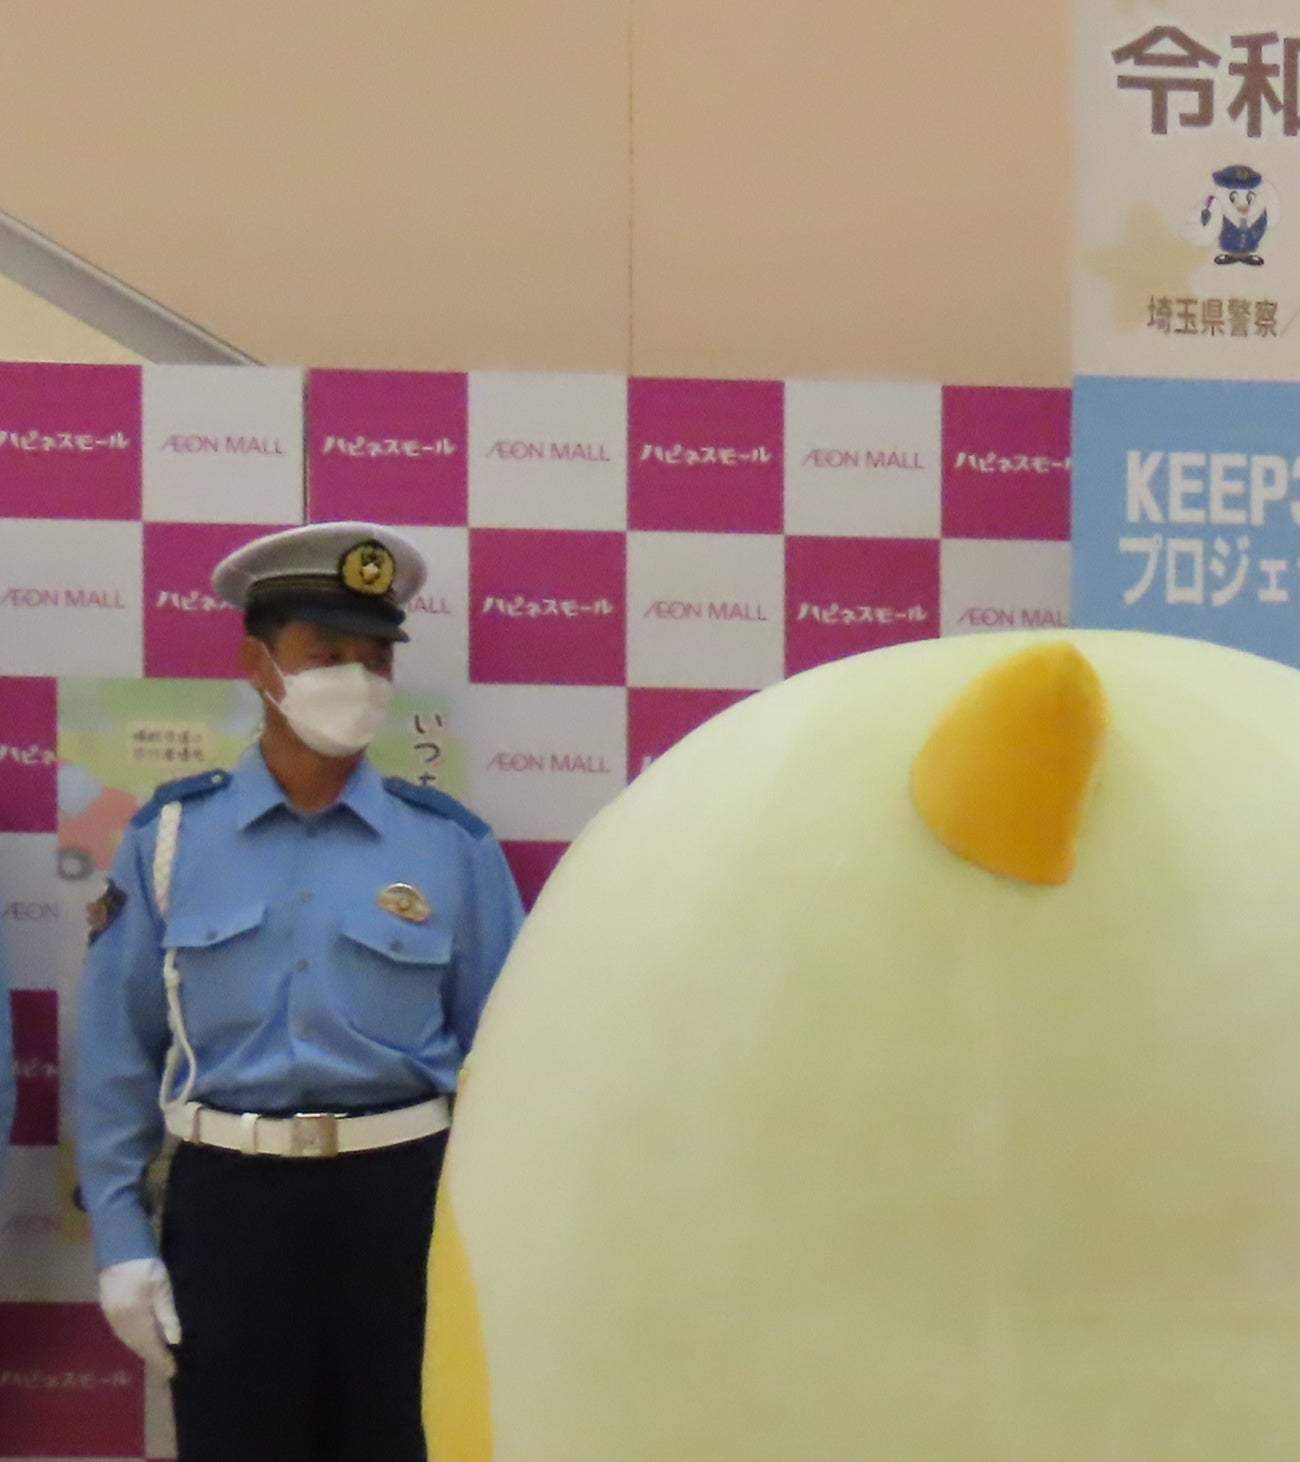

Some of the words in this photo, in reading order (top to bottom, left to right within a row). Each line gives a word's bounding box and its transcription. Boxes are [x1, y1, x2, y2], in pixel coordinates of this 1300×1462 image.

[226, 434, 286, 455] MALL
[551, 440, 610, 462] MALL
[866, 447, 925, 469] MALL
[65, 587, 125, 609] MALL
[708, 601, 768, 623] MALL
[1021, 606, 1069, 628] MAL
[551, 752, 611, 774] MALL
